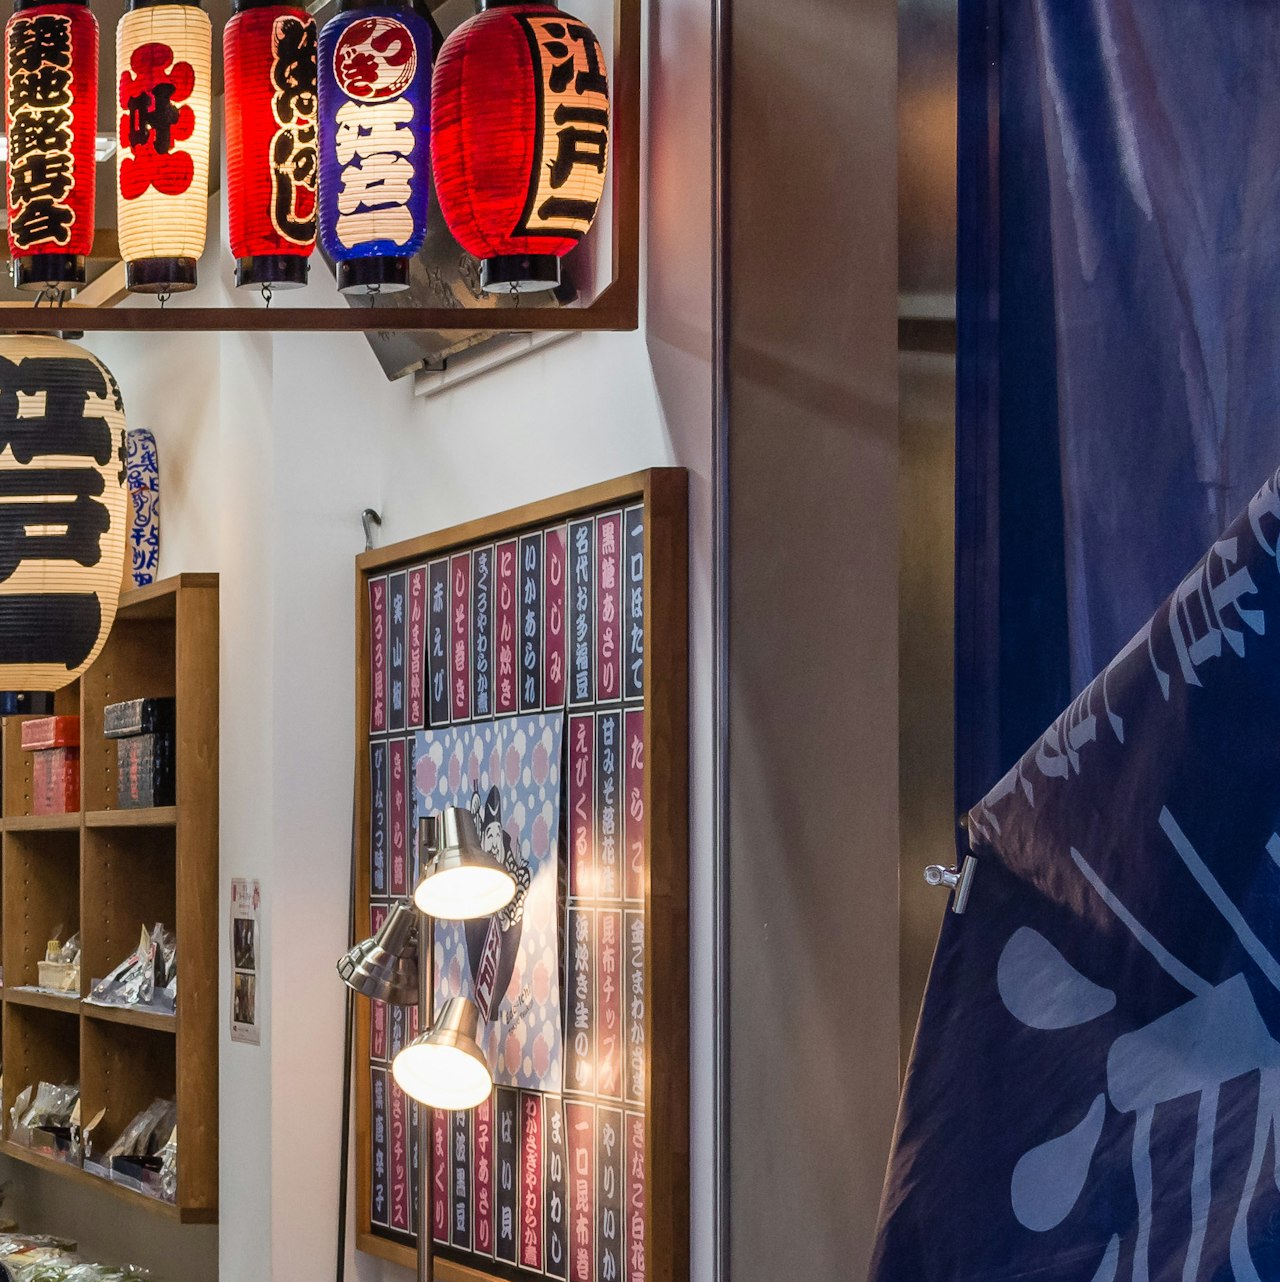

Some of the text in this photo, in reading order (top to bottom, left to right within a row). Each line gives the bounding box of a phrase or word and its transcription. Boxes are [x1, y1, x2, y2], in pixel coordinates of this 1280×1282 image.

[9, 16, 73, 247] 築地銘店会
[335, 102, 414, 246] 江戸一
[543, 20, 610, 234] 江戸一
[373, 584, 384, 728] とろろ昆布
[432, 580, 446, 703] 赤えび
[477, 552, 489, 715] まぐろやわらか煮
[499, 551, 513, 707] にしん炊き
[524, 544, 537, 705] いかあられ
[549, 552, 563, 685] しじみ
[575, 525, 589, 700] 名代お多福豆
[601, 521, 616, 694] 黒糖あさり
[630, 523, 644, 690] 一口ほたて
[601, 716, 616, 894] 甘みそ落花生
[630, 734, 644, 874] たらこ
[601, 914, 617, 1093] 昆布チップス
[500, 1109, 513, 1242] ばい貝
[524, 1099, 538, 1267] わかさぎやわらか煮
[549, 1110, 563, 1265] まいわし
[601, 1122, 616, 1282] やりいか
